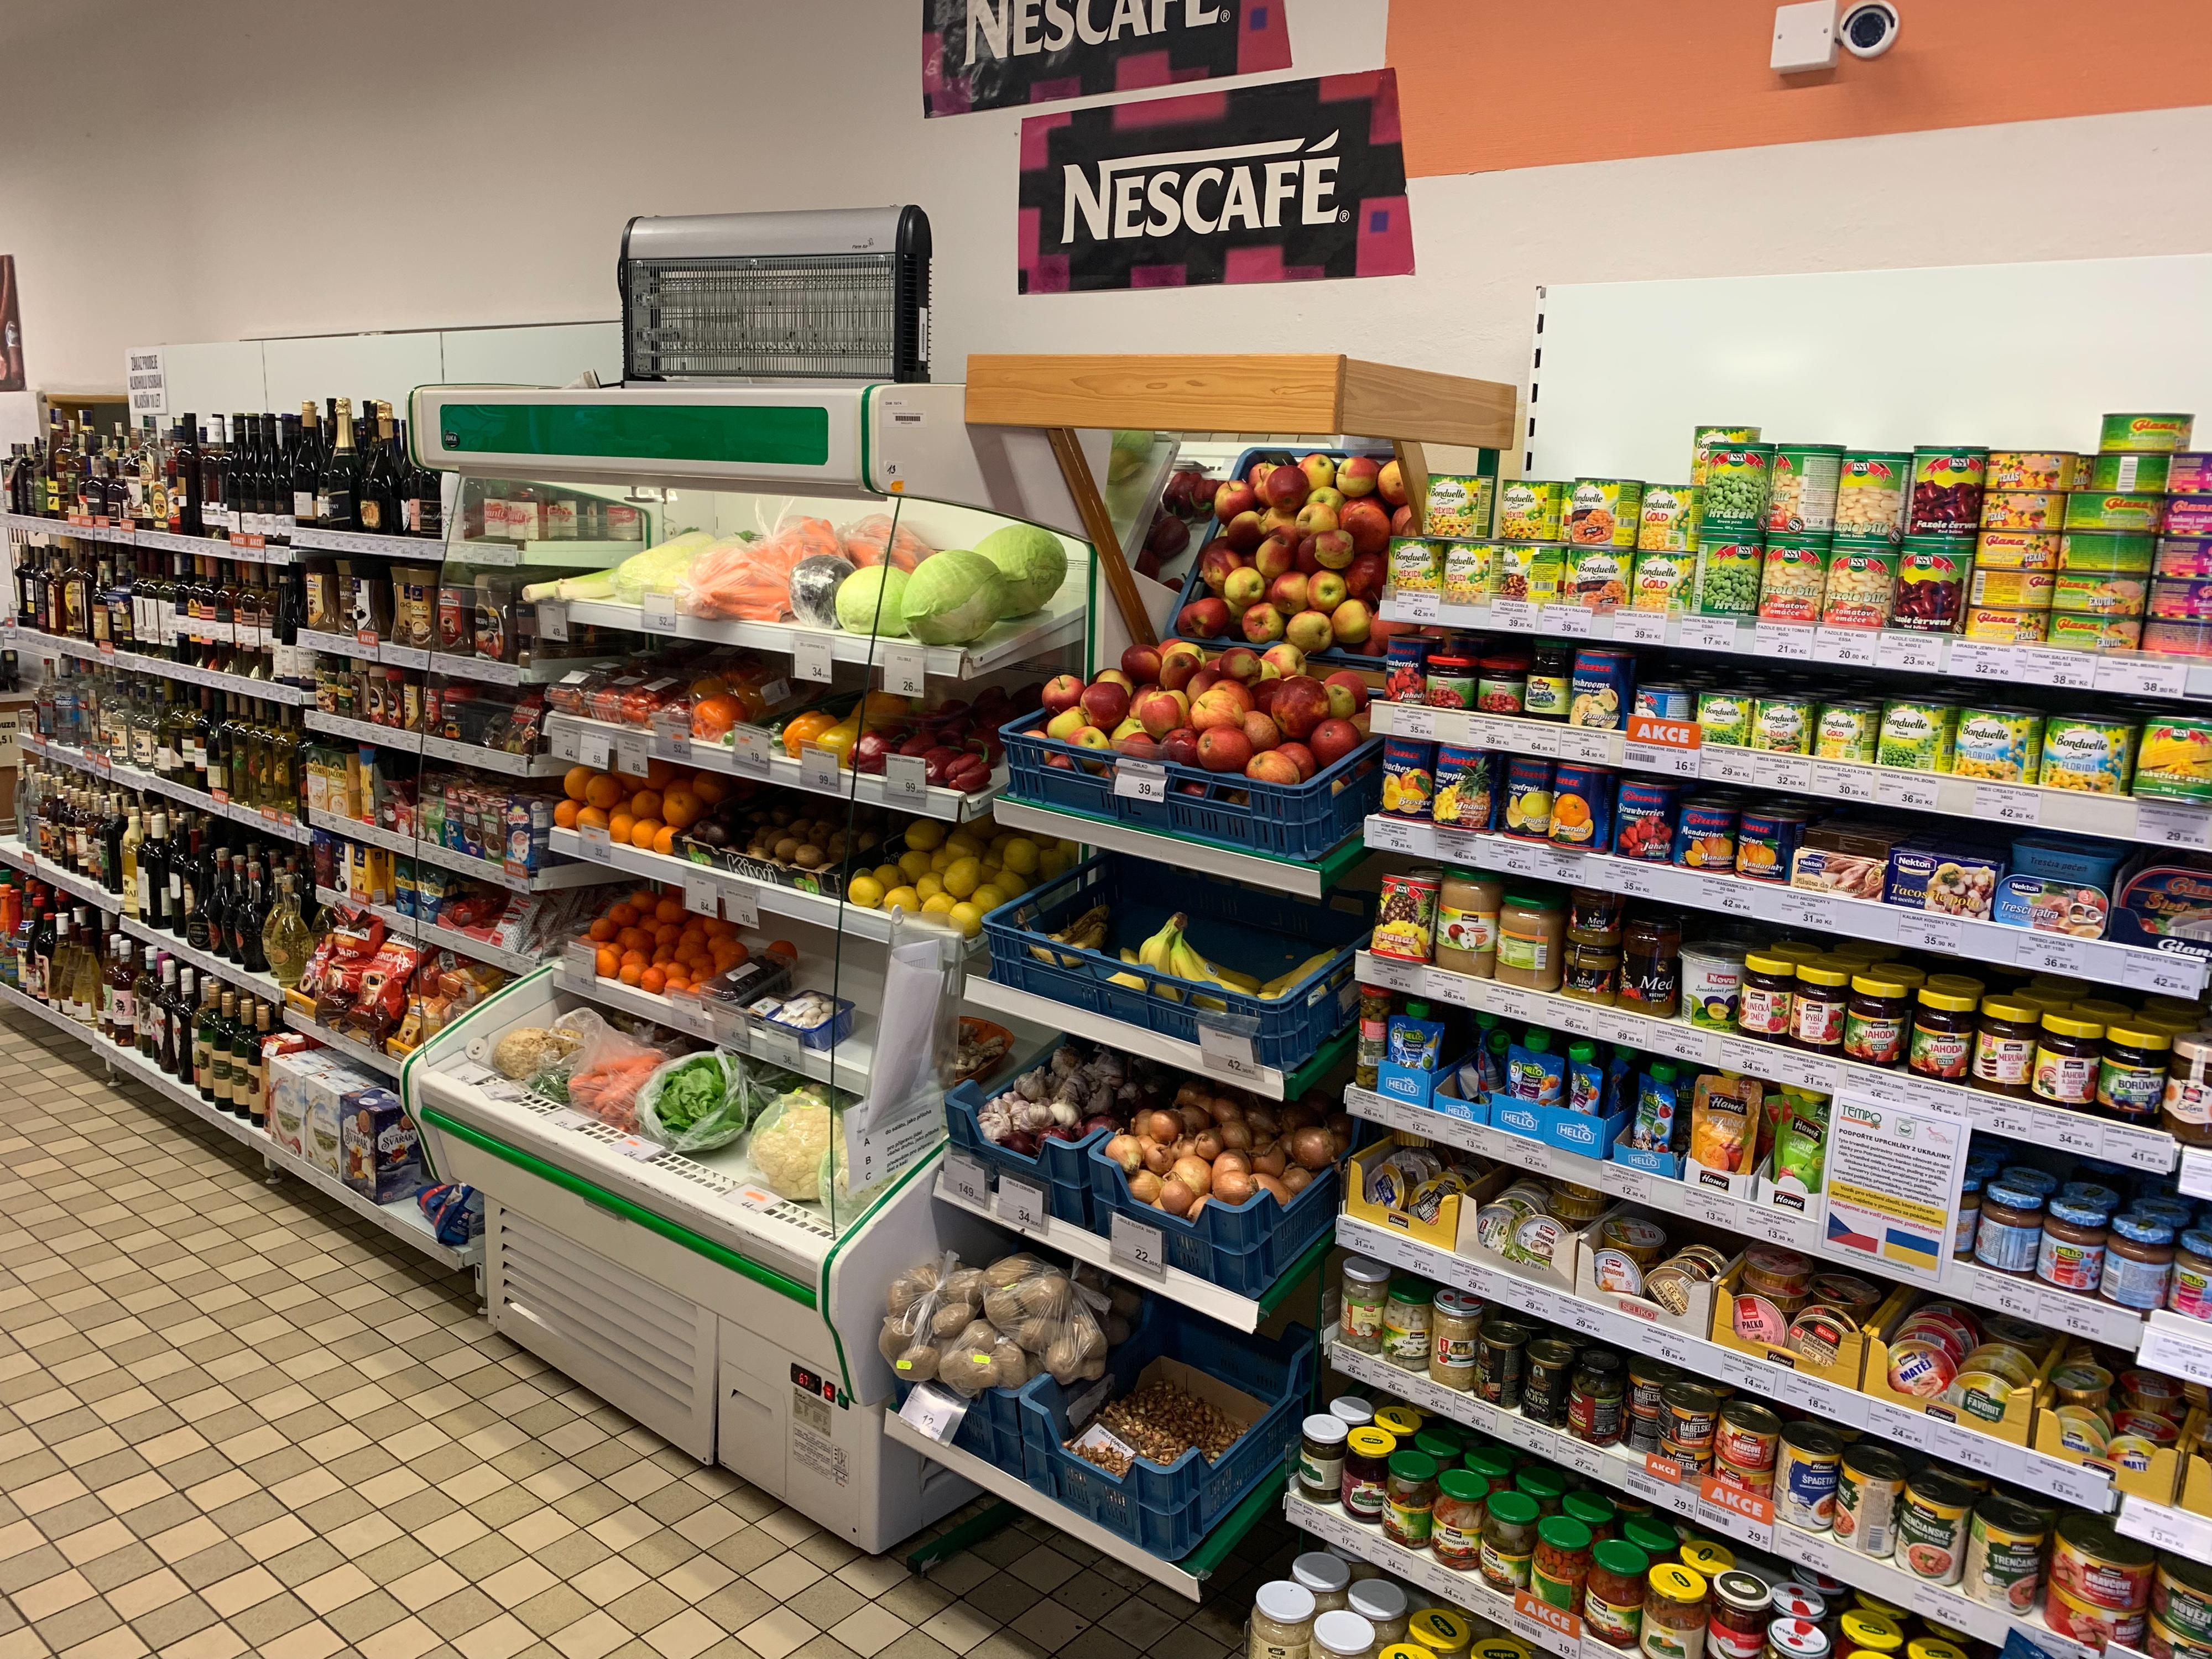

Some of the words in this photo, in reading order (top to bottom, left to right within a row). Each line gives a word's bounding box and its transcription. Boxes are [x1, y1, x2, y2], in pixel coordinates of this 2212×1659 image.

[1061, 129, 1340, 244] NESCAFÉ
[887, 463, 896, 474] 13
[1999, 473, 2020, 482] TEXAS
[1430, 489, 1465, 499] Bonduelle
[1645, 512, 1668, 522] GOLD
[1708, 508, 1755, 520] Hrášek
[1987, 512, 2006, 521] TEXAS
[1917, 520, 1947, 529] Fazole
[1395, 552, 1430, 563] Bonduelle
[1578, 563, 1618, 574] Bonduelle
[1639, 568, 1677, 578] Bonduelle
[1642, 578, 1668, 589] GOLD
[1771, 601, 1809, 610] tomatové
[2089, 597, 2116, 606] EXOTIC
[1835, 607, 1876, 617] tomatové
[1835, 615, 1866, 624] omáčce
[2096, 638, 2122, 646] EXOTIC
[1886, 715, 1927, 730] Bonduelle
[1637, 723, 1690, 744] AKCE
[1770, 729, 1788, 738] DUO
[1963, 724, 2008, 740] Bonduelle
[2056, 735, 2107, 752] Bonduelle
[1965, 750, 1996, 761] FLORIDA
[307, 765, 325, 775] JACOBS
[2062, 761, 2096, 773] FLORIDA
[327, 770, 346, 780] JACOBS
[1618, 802, 1665, 817] Strawberries
[508, 813, 529, 822] GRANKO
[1681, 825, 1724, 839] Mandarines
[507, 862, 524, 875] AKCE
[1741, 858, 1784, 872] Mandarinky
[1897, 856, 1933, 870] Nekton
[1891, 884, 1929, 899] Tacos
[2011, 882, 2039, 893] Nekton
[1587, 916, 1606, 926] Med
[1639, 975, 1674, 991] Med
[1708, 973, 1737, 985] Nova
[1746, 1000, 1770, 1014] LINECKÁ
[1805, 1009, 1824, 1022] RYBÍZ
[1863, 1029, 1896, 1040] JAHODA
[1928, 1043, 1963, 1054] JAHODA
[1998, 1051, 2028, 1063] MERUŇKA
[1387, 1079, 1416, 1094] HELLO
[2118, 1078, 2163, 1091] BORŮVKA
[1710, 1096, 1745, 1113] Hamé
[1447, 1105, 1472, 1119] HELLO
[1842, 1104, 1882, 1124] TEMPO
[1504, 1113, 1535, 1128] HELLO
[1559, 1125, 1592, 1141] HELLO
[1794, 1118, 1820, 1139] Hamé
[1839, 1128, 1874, 1141] PODPOŘTE
[864, 1138, 870, 1146] A
[1790, 1136, 1814, 1154] JABLKO
[865, 1156, 871, 1165] B
[1630, 1155, 1660, 1168] HELLO
[1702, 1174, 1728, 1188] Hamé
[1776, 1194, 1803, 1209] Hamé
[1830, 1200, 1860, 1214] Děkujeme
[1389, 1215, 1407, 1227] Hamé
[1622, 1302, 1655, 1320] SELIKO
[1816, 1326, 1836, 1340] SELIKO
[1769, 1351, 1793, 1367] Hamé
[1525, 1390, 1550, 1406] OLIVES
[1968, 1396, 2001, 1415] FAVORIT
[1681, 1422, 1711, 1435] ĎÁBELSKÉ
[1650, 1461, 1676, 1477] AKCE
[1711, 1486, 1764, 1519] AKCE
[2085, 1572, 2132, 1590] BRAVČOVÉ
[1524, 1601, 1570, 1631] AKCE
